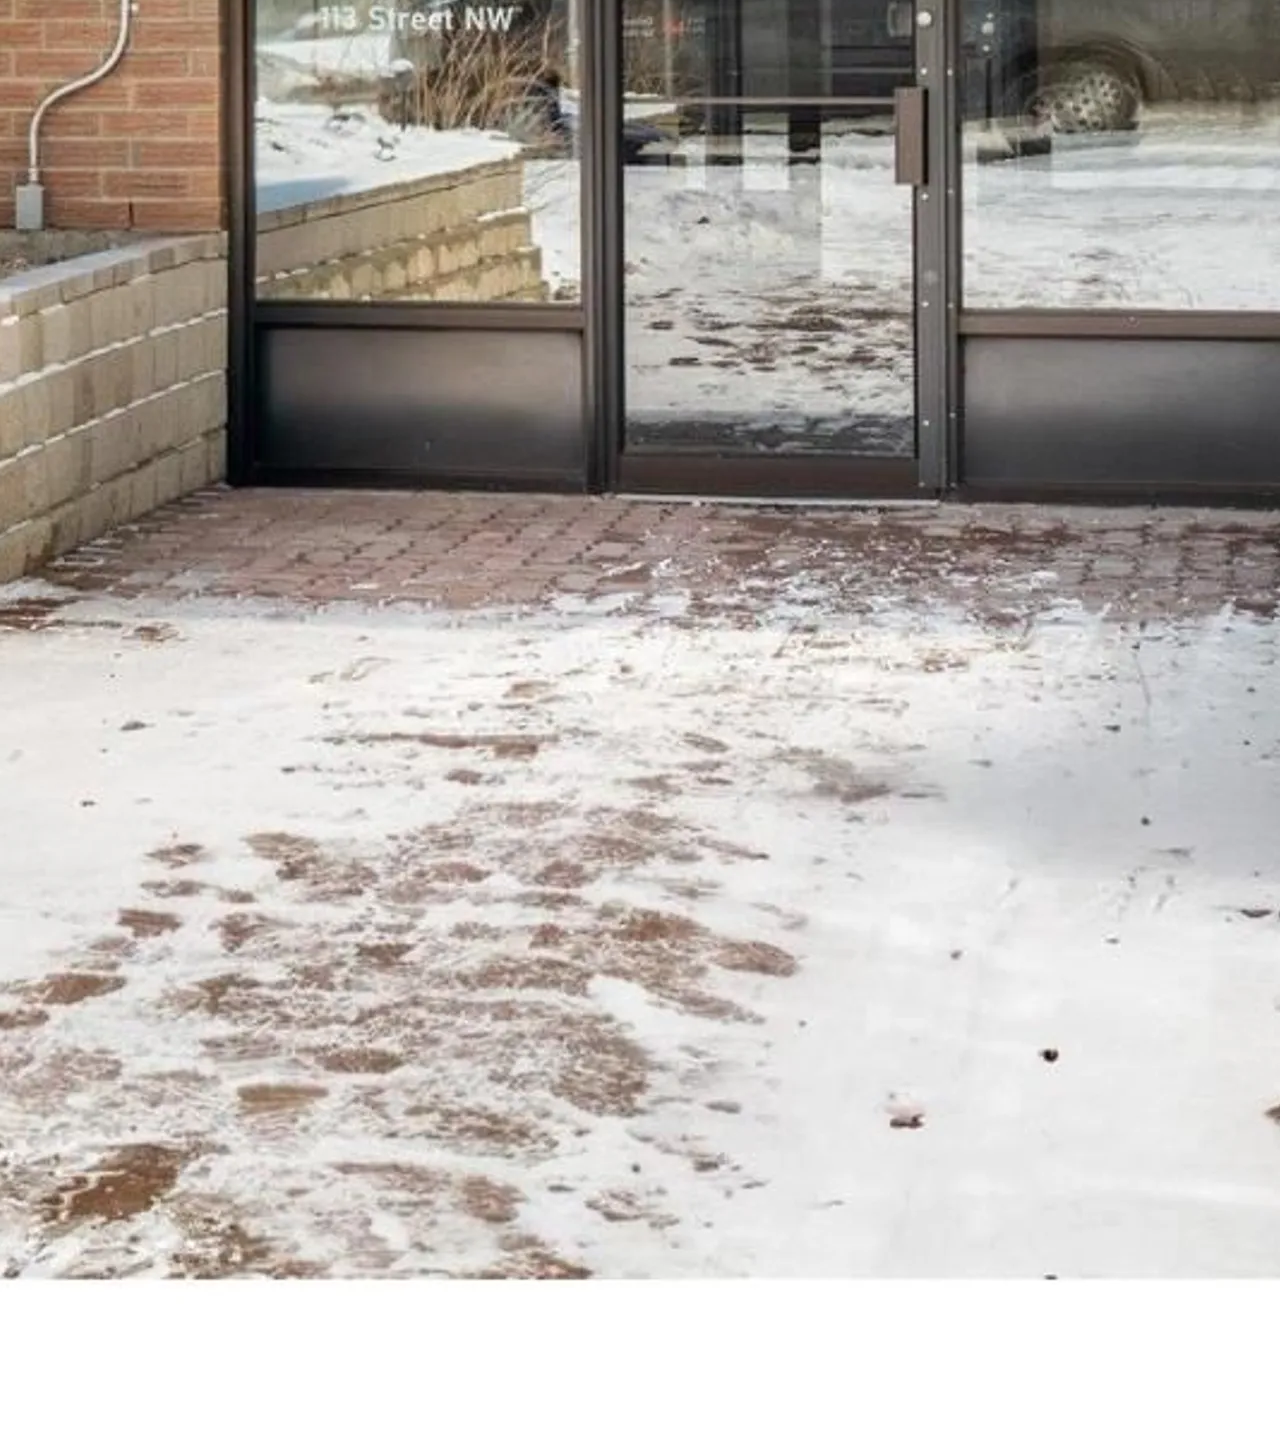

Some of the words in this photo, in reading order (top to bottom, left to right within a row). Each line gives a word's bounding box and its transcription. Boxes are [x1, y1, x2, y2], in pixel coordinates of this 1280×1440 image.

[320, 7, 357, 29] 113
[370, 6, 453, 30] Street
[466, 7, 514, 31] NW
